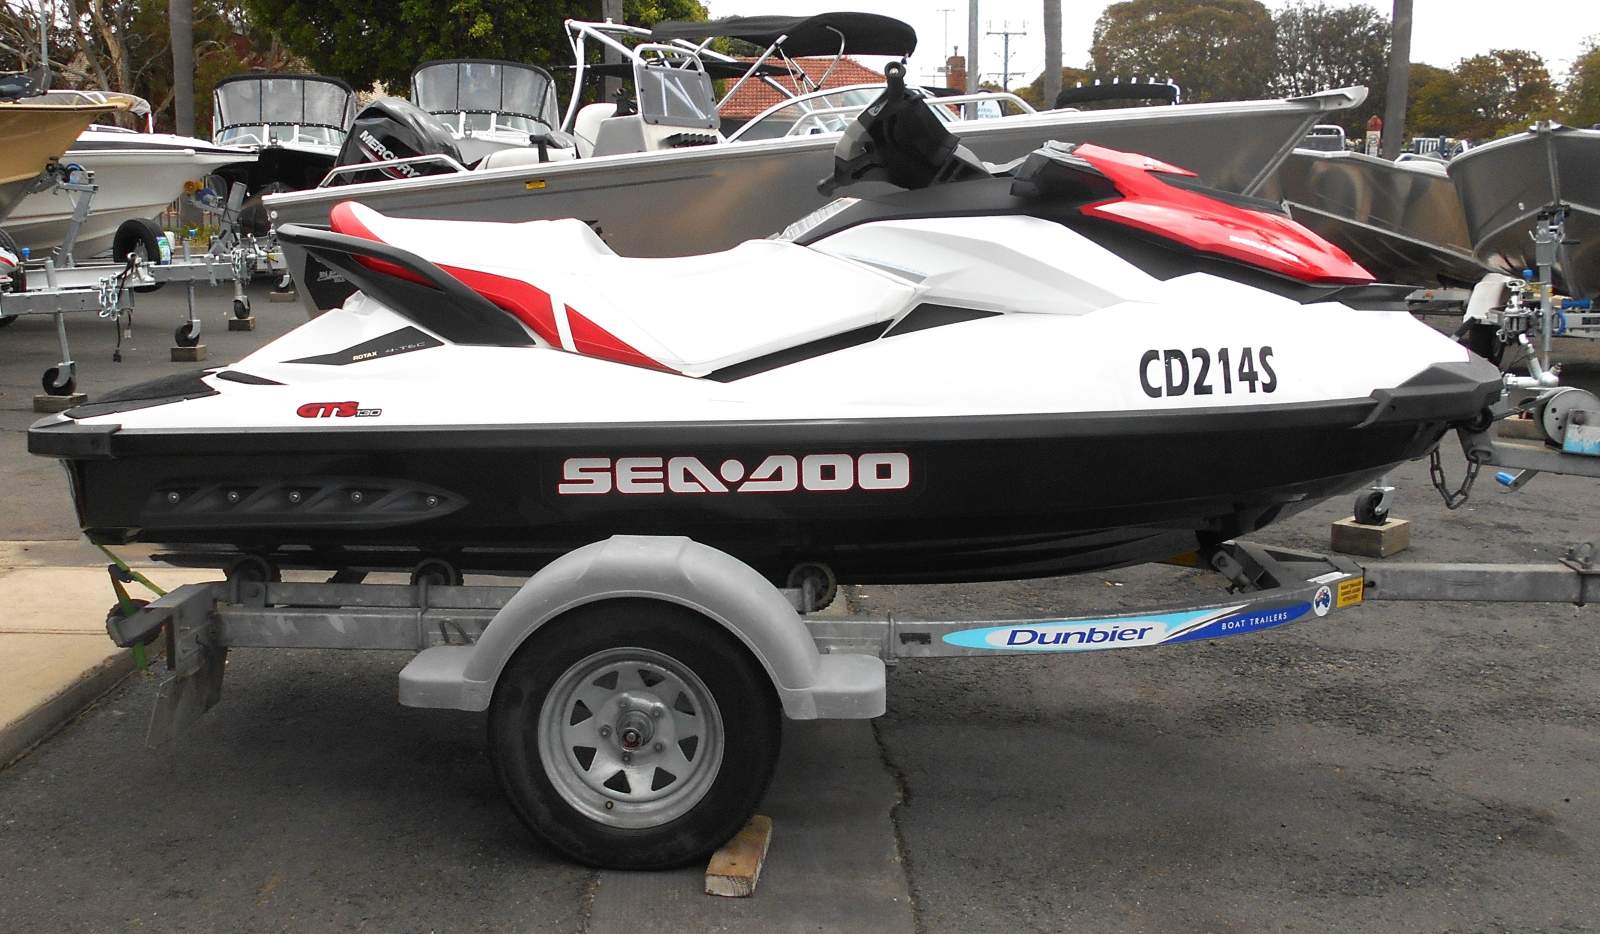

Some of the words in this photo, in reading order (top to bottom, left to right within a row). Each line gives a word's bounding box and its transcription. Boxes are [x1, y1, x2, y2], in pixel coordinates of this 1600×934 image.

[360, 130, 420, 177] MERCRY
[352, 351, 378, 361] ROTAX
[1139, 345, 1278, 398] CD214S
[1221, 620, 1245, 630] BOAT
[1250, 612, 1287, 625] TRAILERS
[1006, 625, 1153, 646] Dunbier
